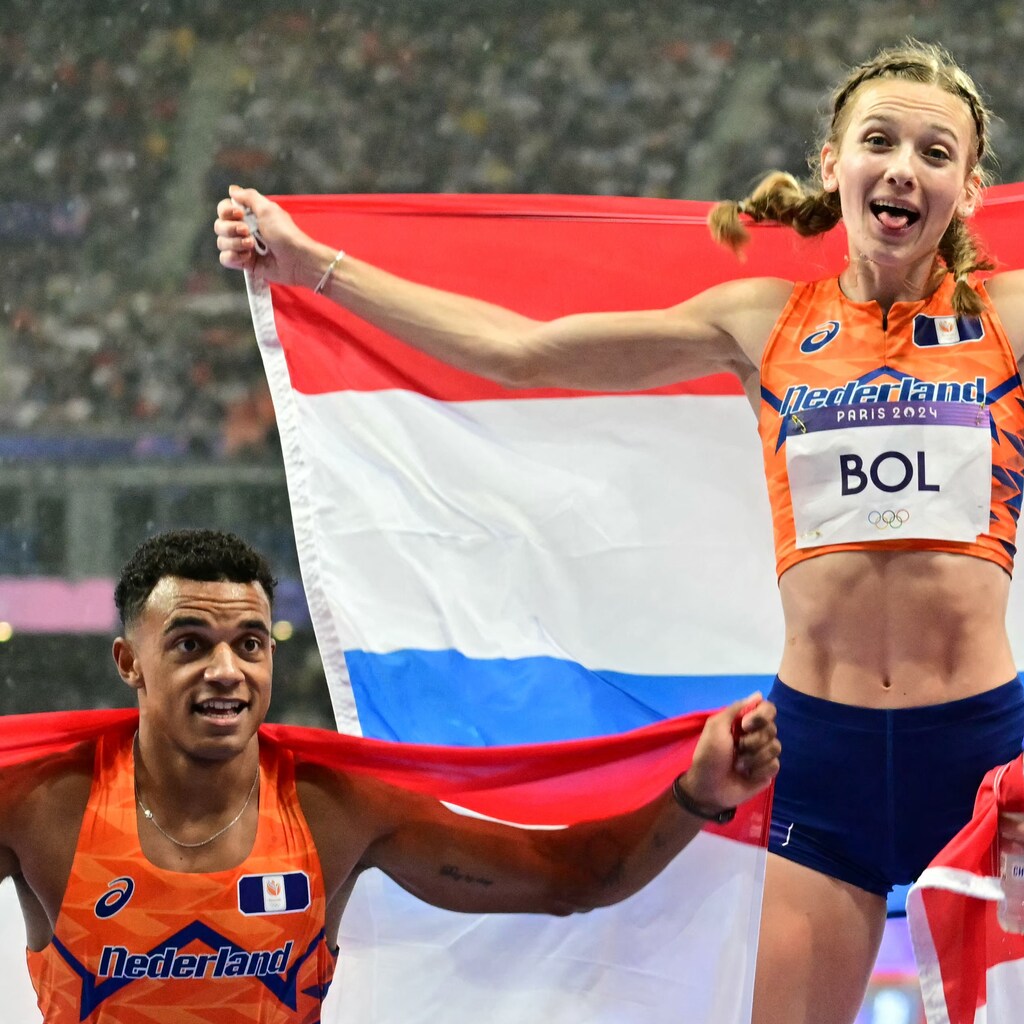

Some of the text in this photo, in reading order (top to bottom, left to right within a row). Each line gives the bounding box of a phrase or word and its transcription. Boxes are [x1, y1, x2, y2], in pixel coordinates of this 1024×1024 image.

[836, 406, 938, 422] PARIS 2024
[839, 451, 940, 496] BOL
